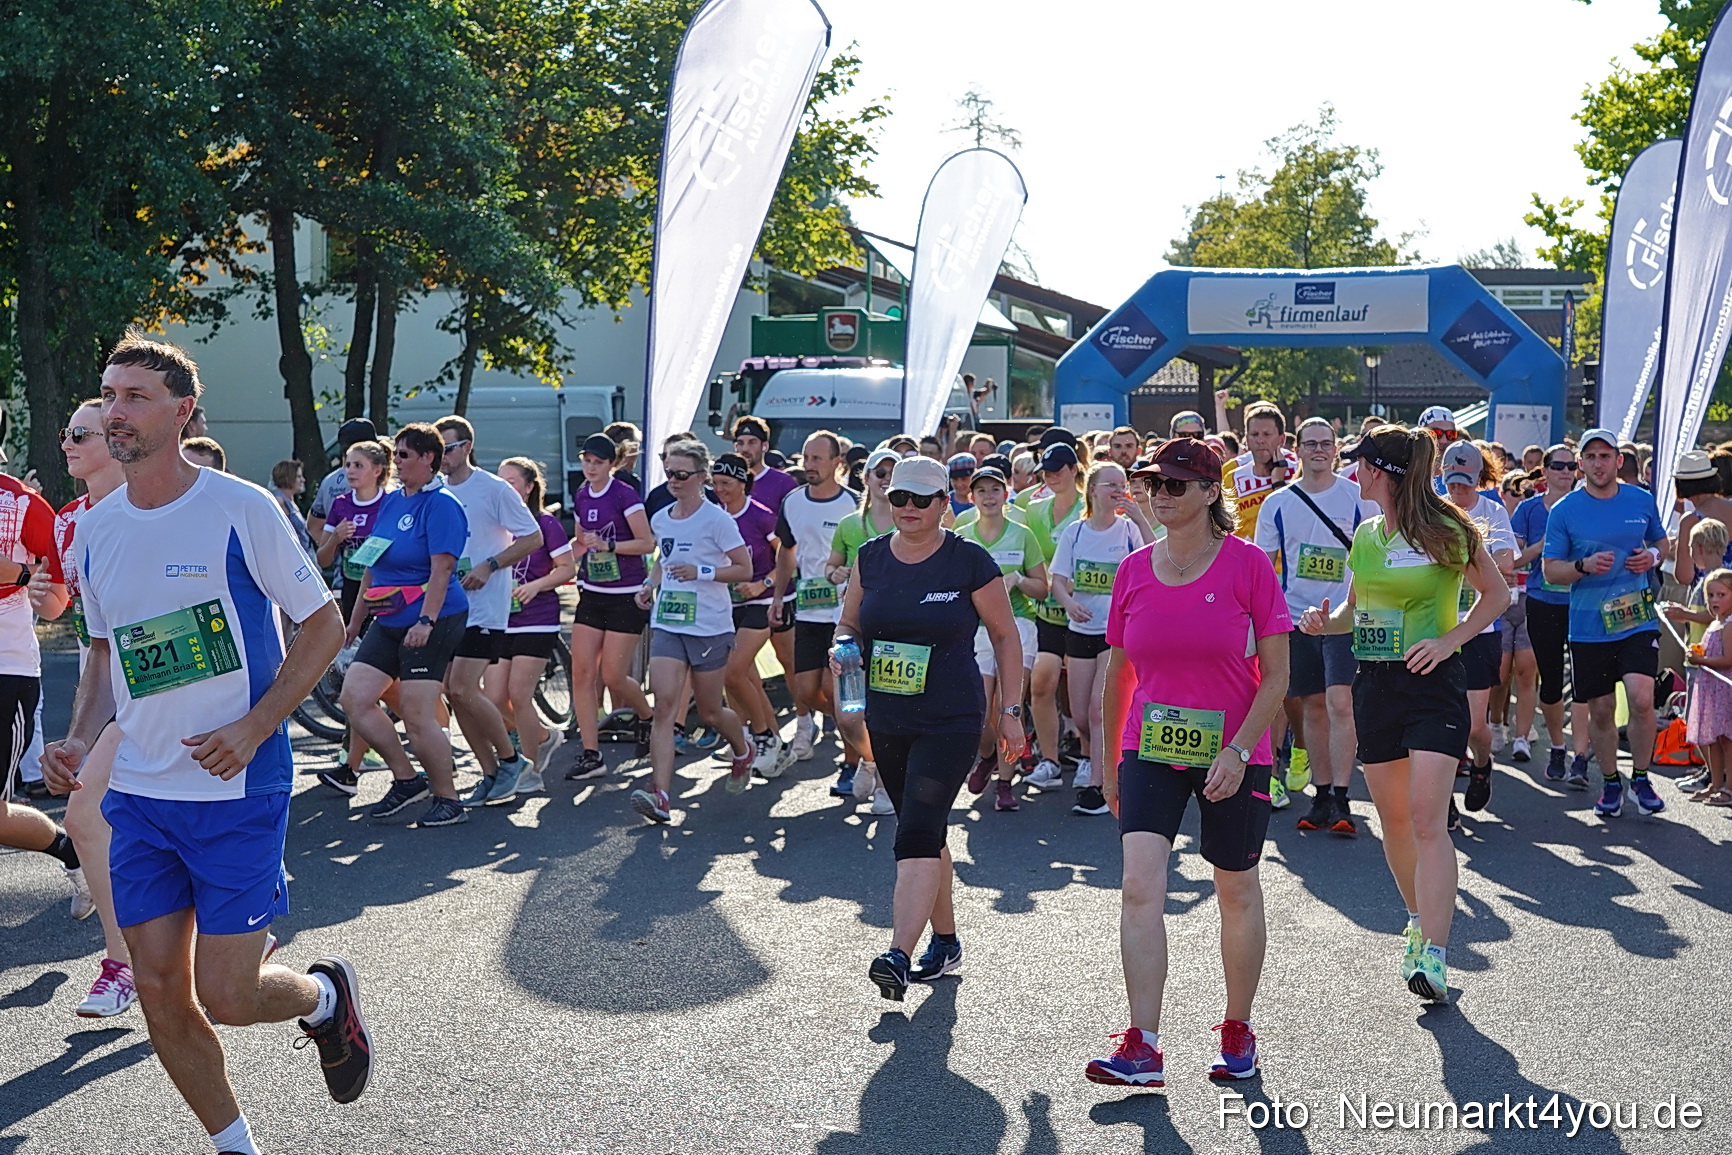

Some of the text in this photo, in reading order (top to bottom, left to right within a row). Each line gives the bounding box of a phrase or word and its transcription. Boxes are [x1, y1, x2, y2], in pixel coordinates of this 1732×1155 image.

[711, 13, 783, 162] Fischer
[945, 174, 998, 275] Fischer
[1280, 304, 1370, 322] firmenlauf
[1108, 333, 1157, 345] Fischer
[180, 565, 208, 573] PETTER
[1309, 556, 1334, 571] 318
[1085, 571, 1108, 585] 310
[803, 587, 831, 600] 1670
[662, 601, 689, 615] 1228
[1609, 603, 1641, 622] 1946
[1359, 627, 1387, 645] 939
[134, 639, 180, 672] 321
[188, 636, 207, 670] 2022
[124, 659, 137, 685] RUN
[172, 661, 198, 674] Brian
[876, 658, 917, 679] 1416
[878, 676, 909, 686] Rotaro Ana
[915, 665, 924, 689] 2022
[1144, 724, 1154, 753] WALK
[1160, 725, 1202, 749] 899
[1151, 743, 1174, 754] Hillert
[1174, 747, 1210, 758] Marianne
[1209, 734, 1219, 760] 2022
